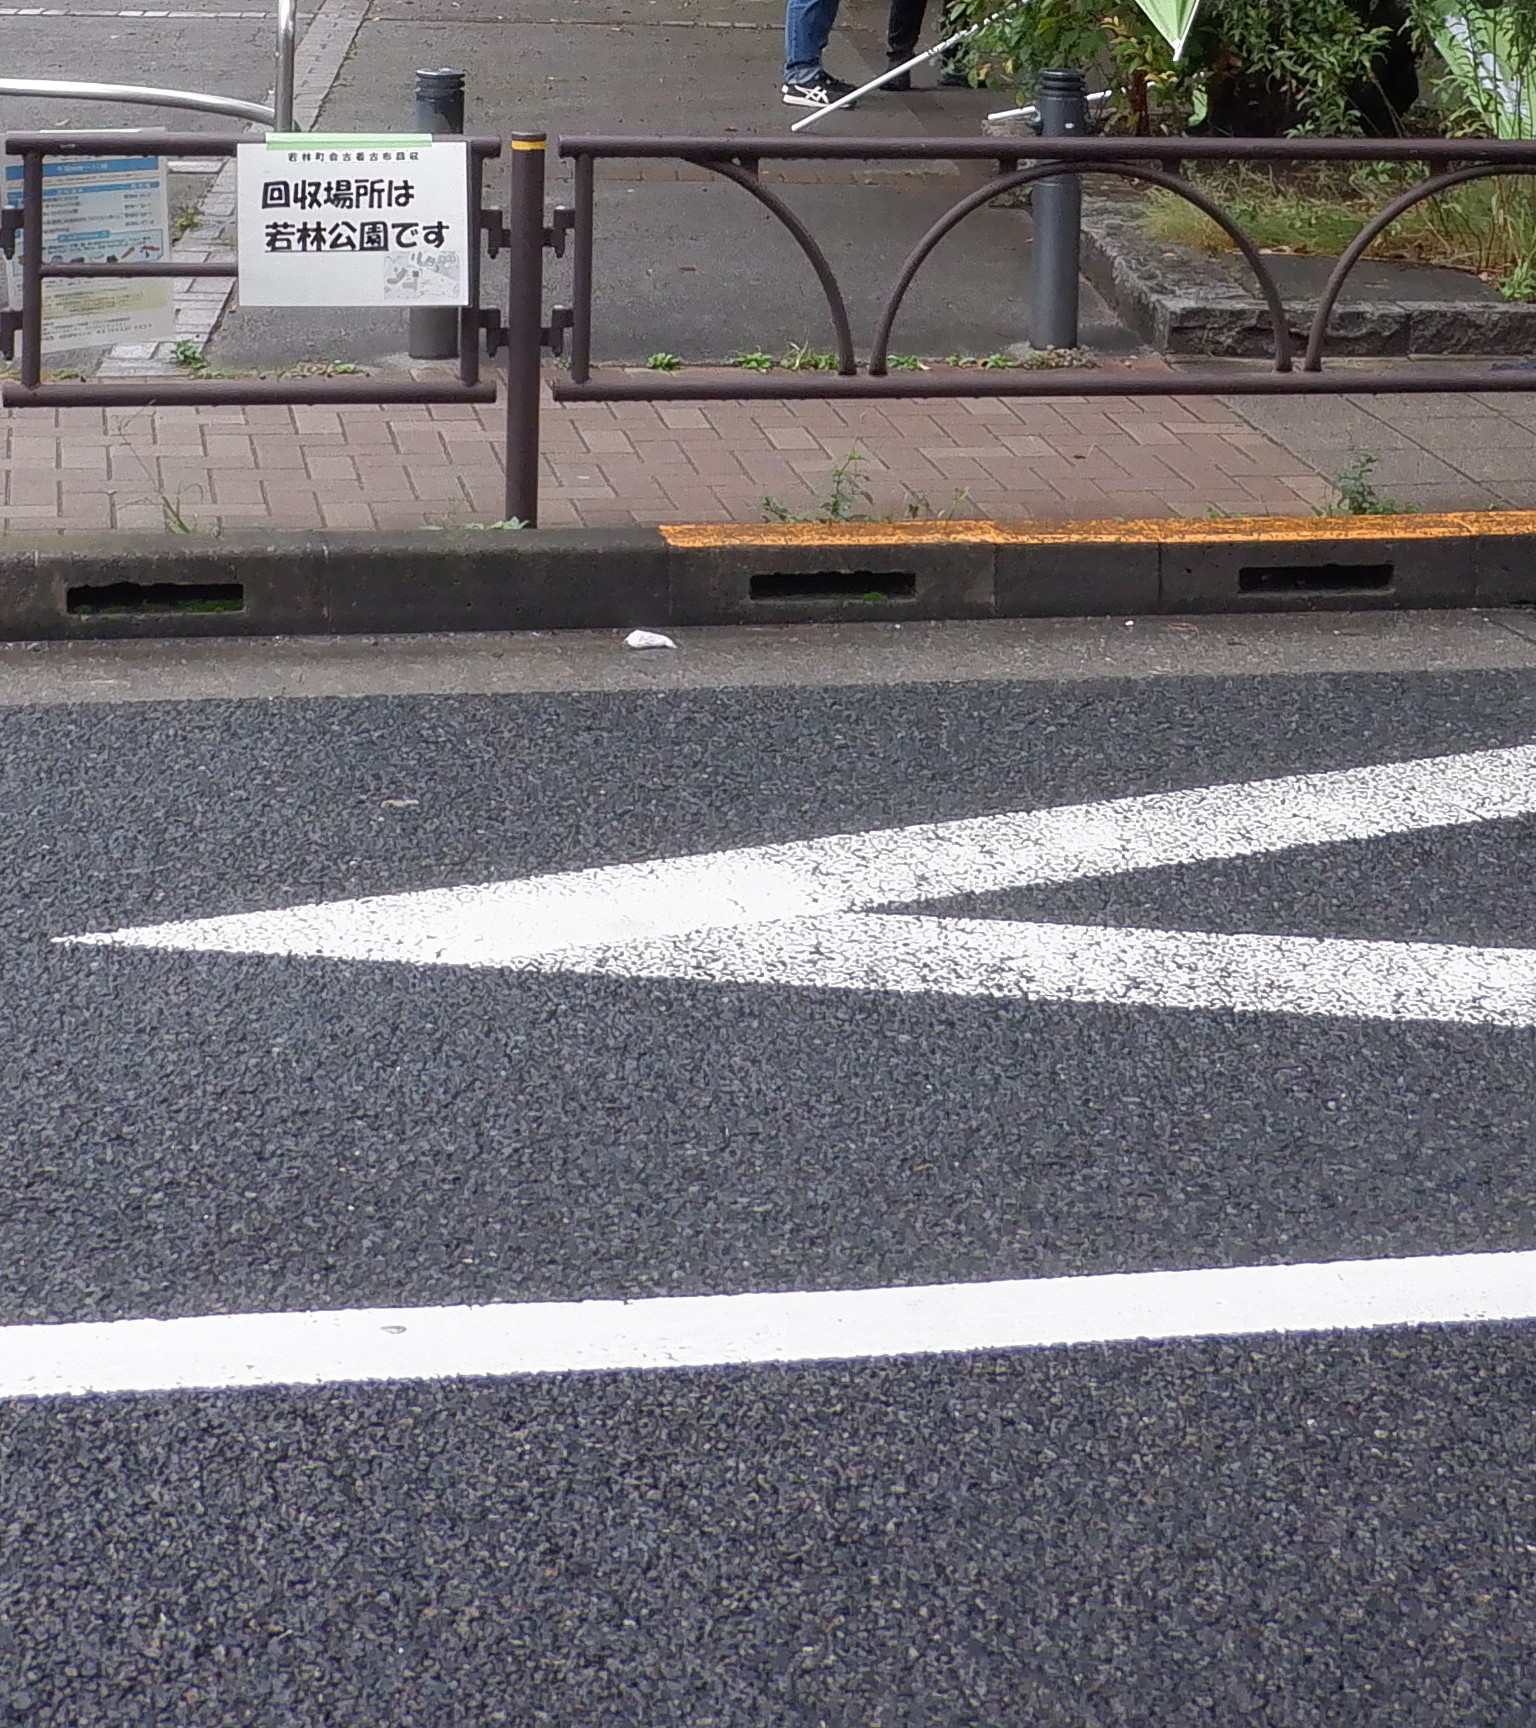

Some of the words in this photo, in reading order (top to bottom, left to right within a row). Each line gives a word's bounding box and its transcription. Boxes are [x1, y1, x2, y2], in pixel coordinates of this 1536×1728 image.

[262, 179, 415, 209] 回収場所は
[264, 221, 450, 252] 若林公園です
